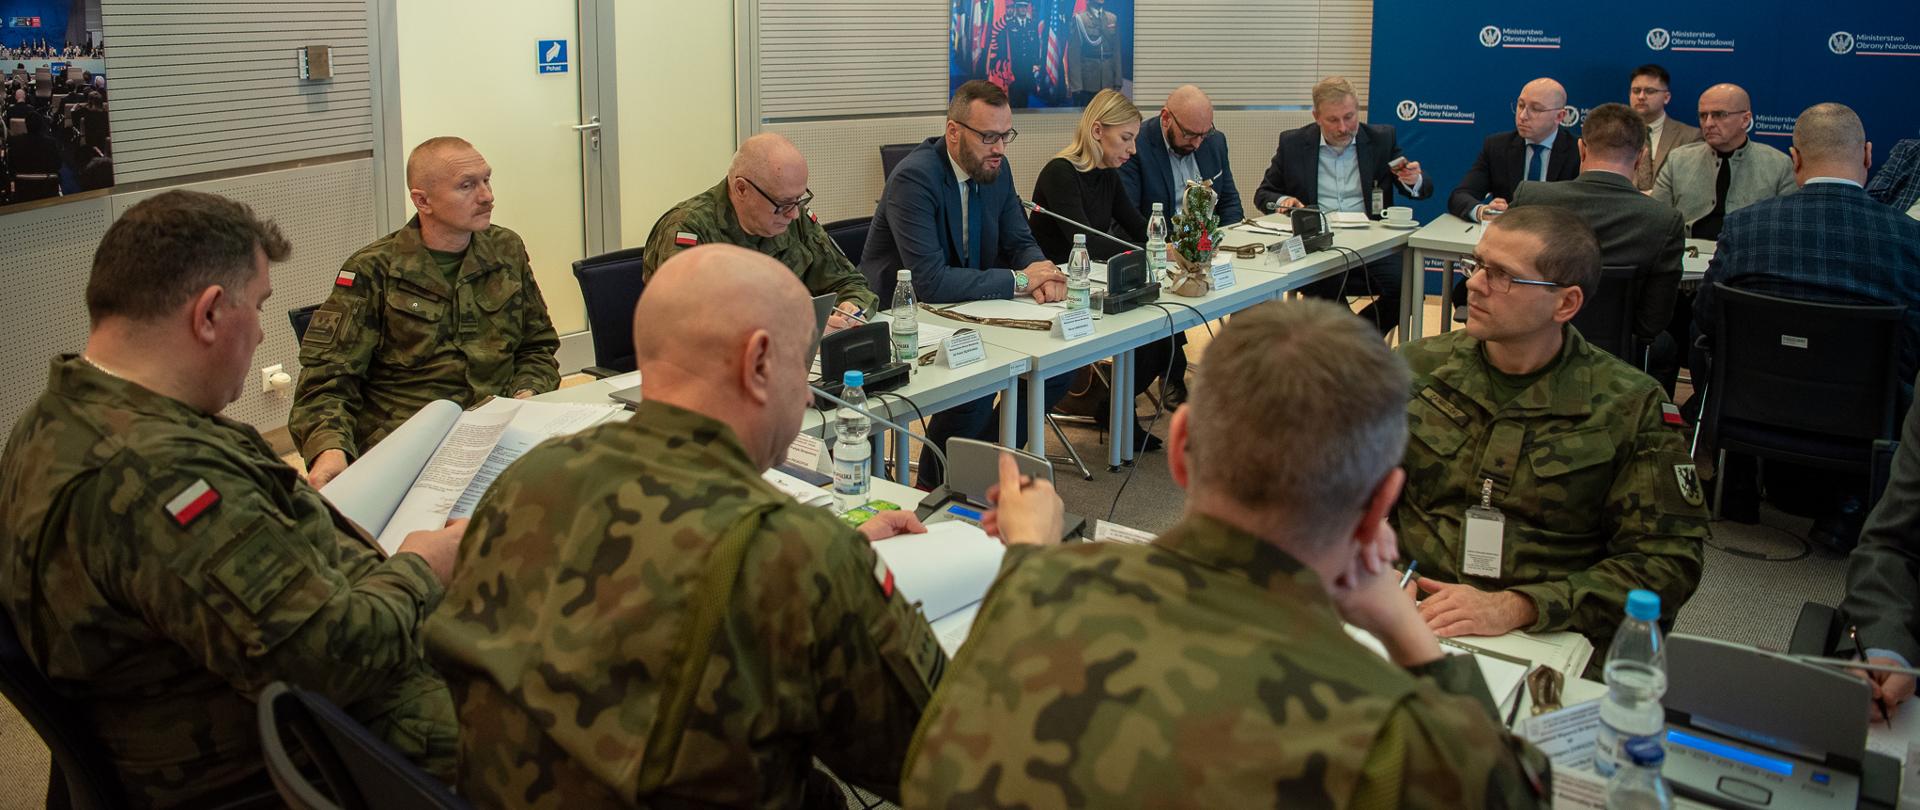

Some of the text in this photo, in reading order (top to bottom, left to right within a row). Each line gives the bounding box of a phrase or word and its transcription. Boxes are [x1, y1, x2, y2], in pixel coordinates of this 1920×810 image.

[1526, 36, 1561, 44] Narodowej
[1856, 34, 1905, 42] Ministerstwo
[1671, 38, 1735, 47] Obrony Narodowej
[1856, 42, 1884, 50] Obrony
[1442, 111, 1475, 119] Narodowej
[1755, 114, 1797, 122] Ministerstw
[1755, 122, 1781, 130] Obrony
